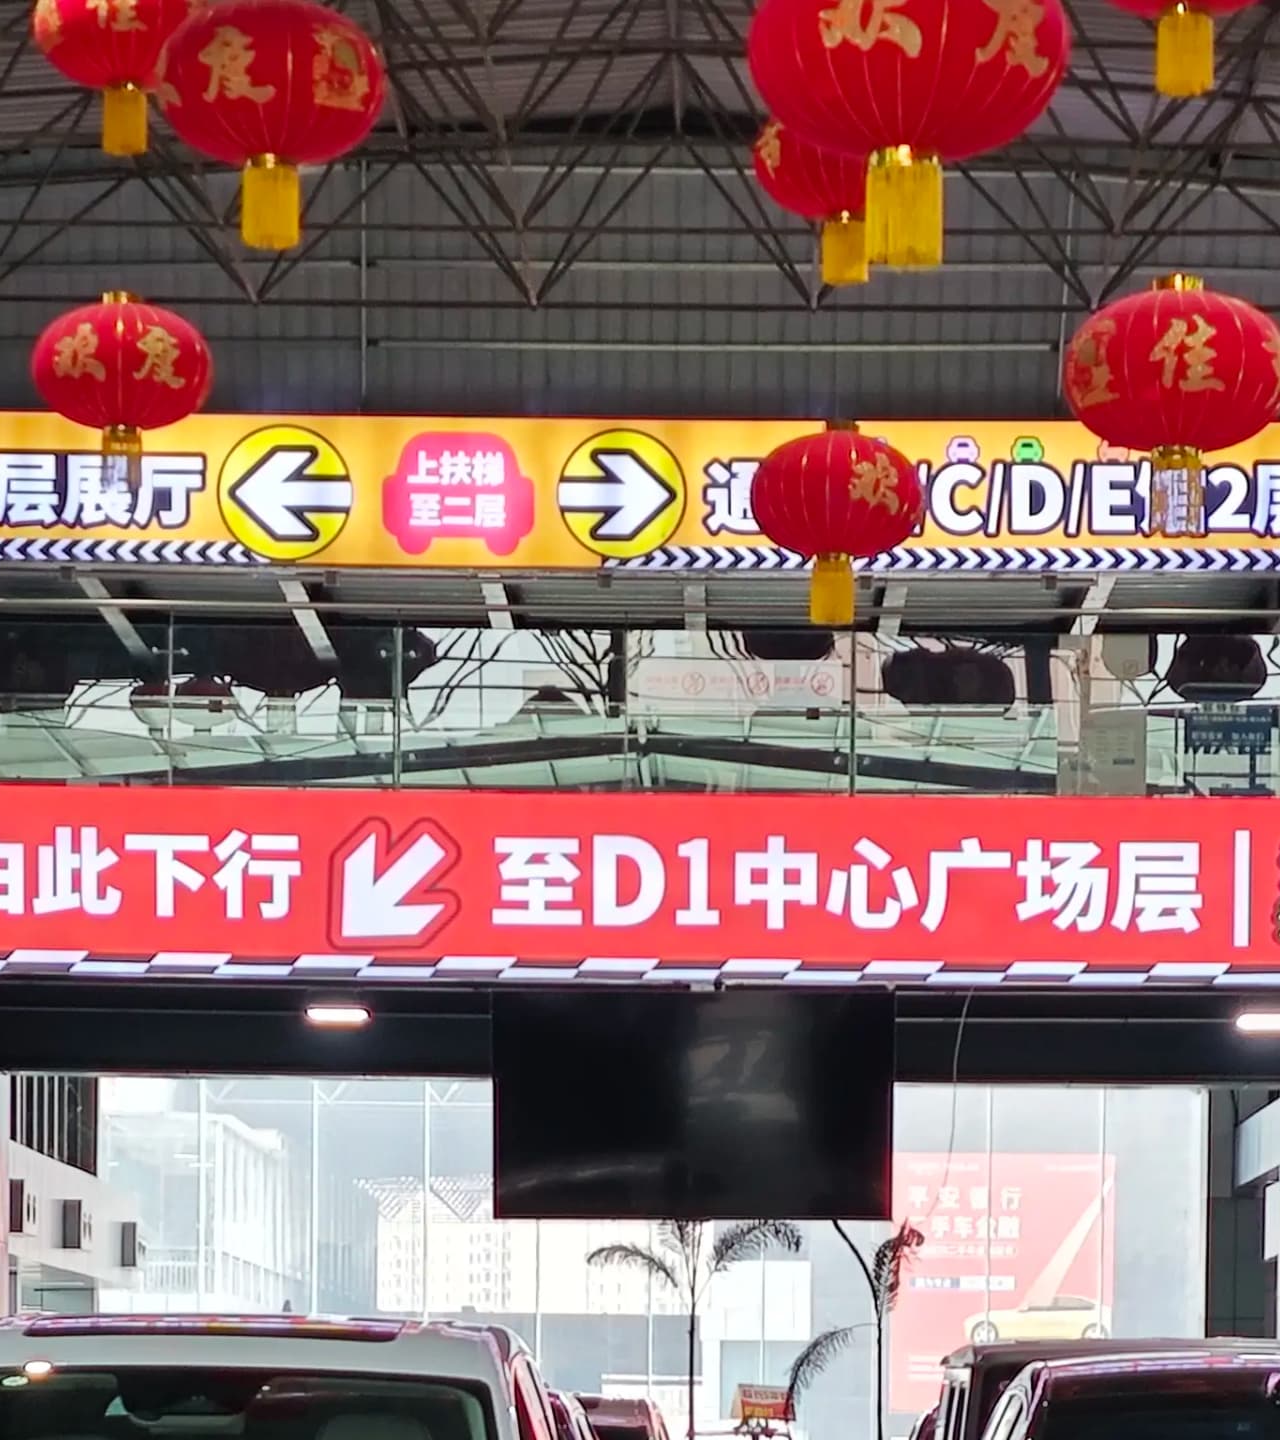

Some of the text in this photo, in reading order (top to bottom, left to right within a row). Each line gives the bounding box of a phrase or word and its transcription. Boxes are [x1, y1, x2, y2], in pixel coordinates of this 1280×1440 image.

[406, 449, 505, 487] 上扶梯
[408, 493, 506, 528] 至二层
[491, 834, 1204, 933] 至D1中心广场层
